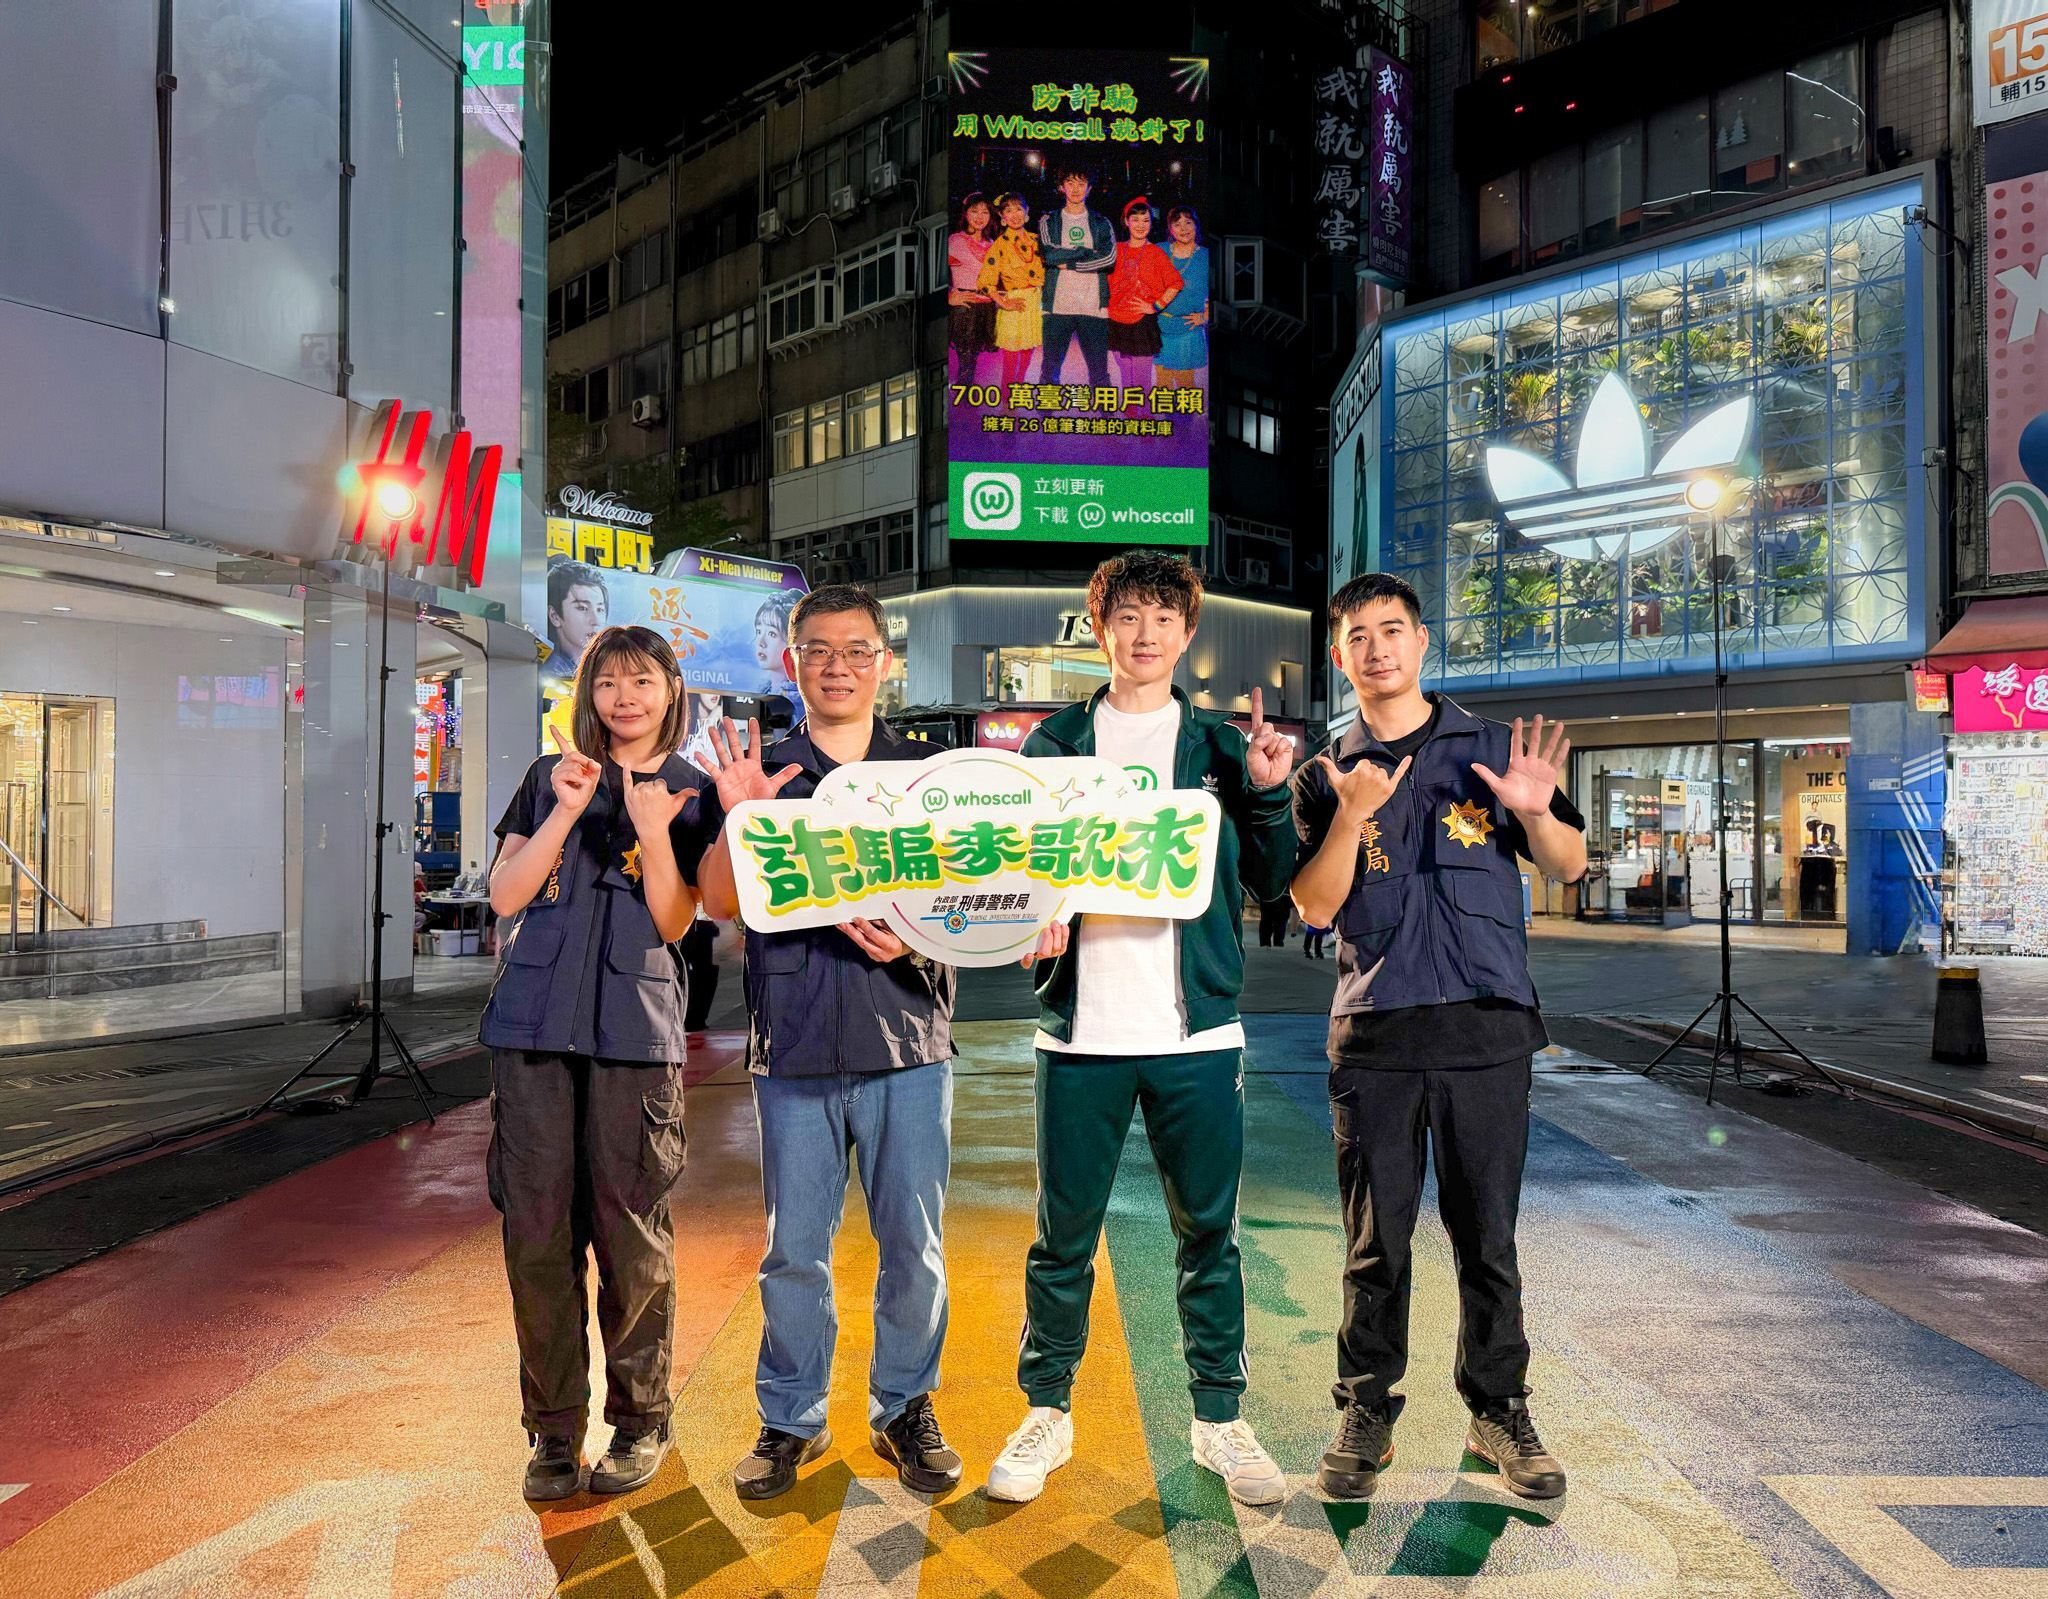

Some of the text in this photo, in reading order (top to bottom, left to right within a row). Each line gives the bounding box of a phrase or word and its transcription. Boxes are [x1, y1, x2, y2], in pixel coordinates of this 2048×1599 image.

[1031, 83, 1138, 114] 防詐騙
[952, 114, 979, 138] 用
[983, 114, 1106, 141] Whoscall
[1314, 65, 1368, 253] 我就厲害
[1376, 64, 1409, 236] 我就厲害
[951, 385, 1204, 415] 700 萬臺灣用戶信賴
[1334, 337, 1381, 450] SUPERSTAR
[982, 416, 1174, 436] 擁有 26 億筆數據的資料庫
[1033, 478, 1105, 496] 立刻更新
[559, 484, 654, 526] Welcome
[1033, 506, 1069, 525] 下載
[1111, 507, 1195, 525] whoscall
[698, 556, 784, 584] Xi-Men Walker
[1806, 772, 1833, 787] THE
[953, 788, 1032, 806] whoscall
[1801, 794, 1842, 803] ORIGINALS
[741, 806, 1206, 914] 詐騙麥歌來
[957, 893, 1031, 912] 刑事警察局
